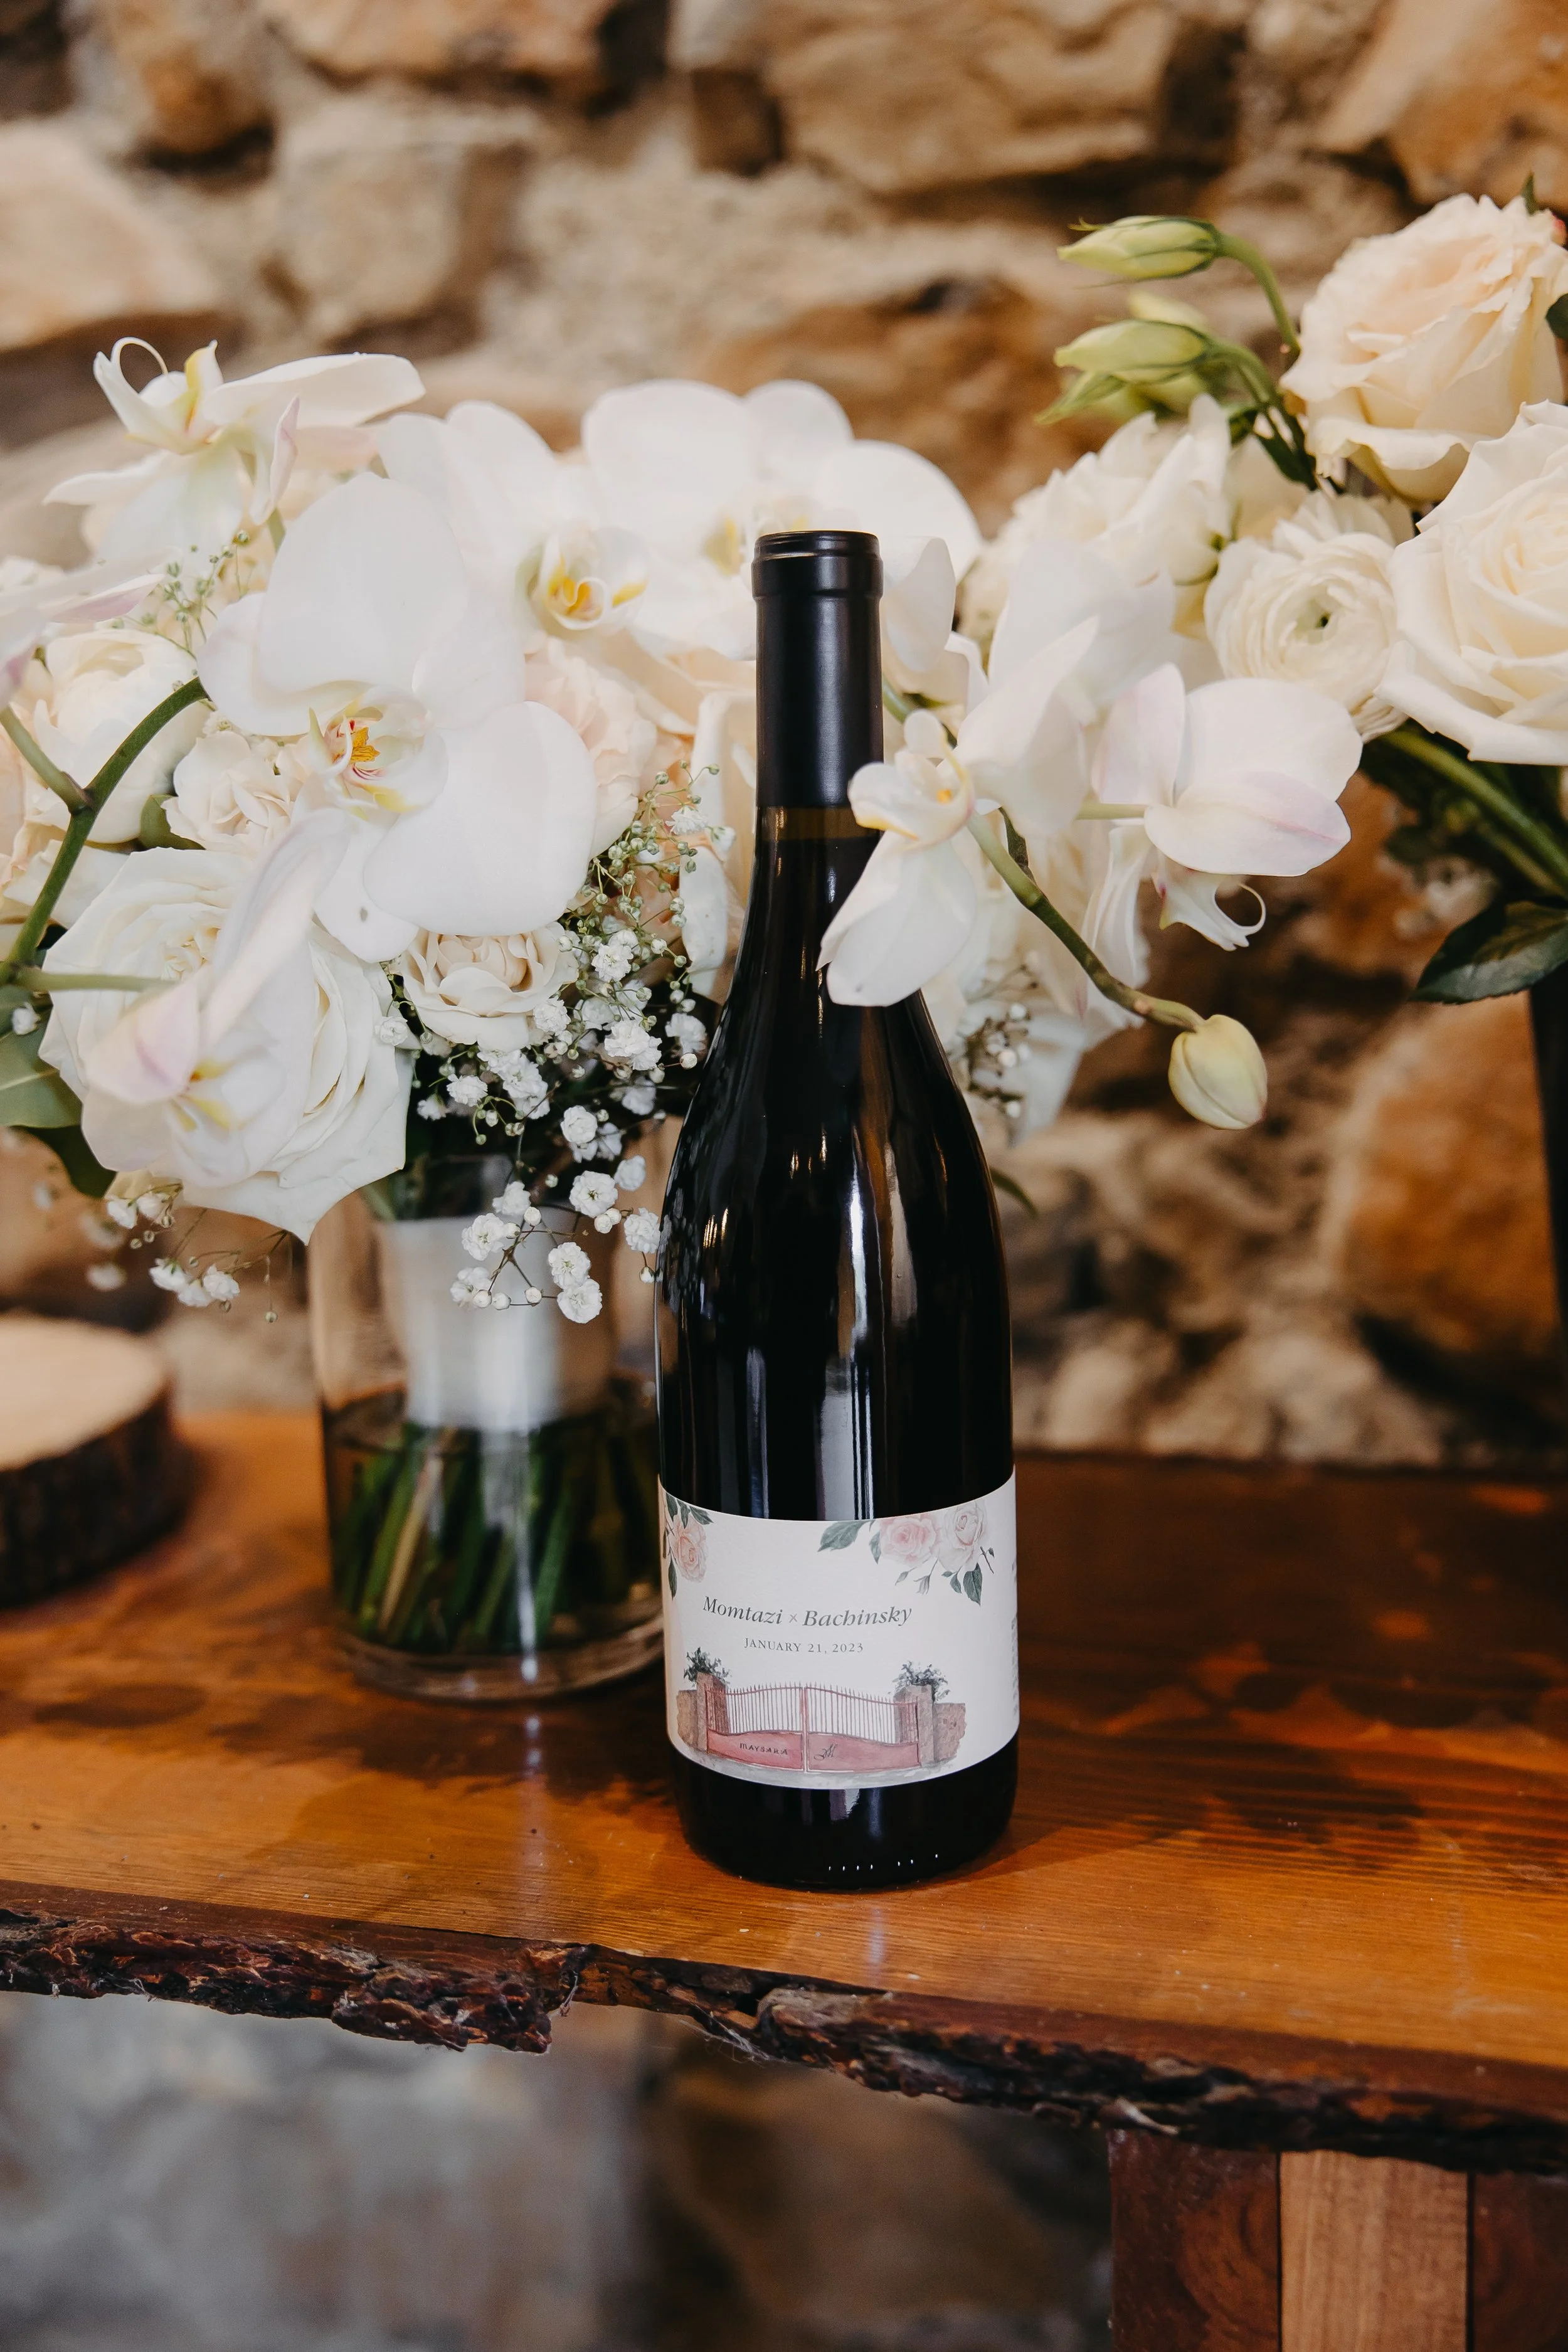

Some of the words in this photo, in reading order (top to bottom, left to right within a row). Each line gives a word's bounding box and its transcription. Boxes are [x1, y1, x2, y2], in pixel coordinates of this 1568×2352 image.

[702, 1596, 783, 1625] Momtazi
[802, 1606, 913, 1627] Bachinsky
[744, 1638, 802, 1653] JANUARY
[807, 1643, 827, 1655] 21,
[832, 1643, 864, 1653] 2023
